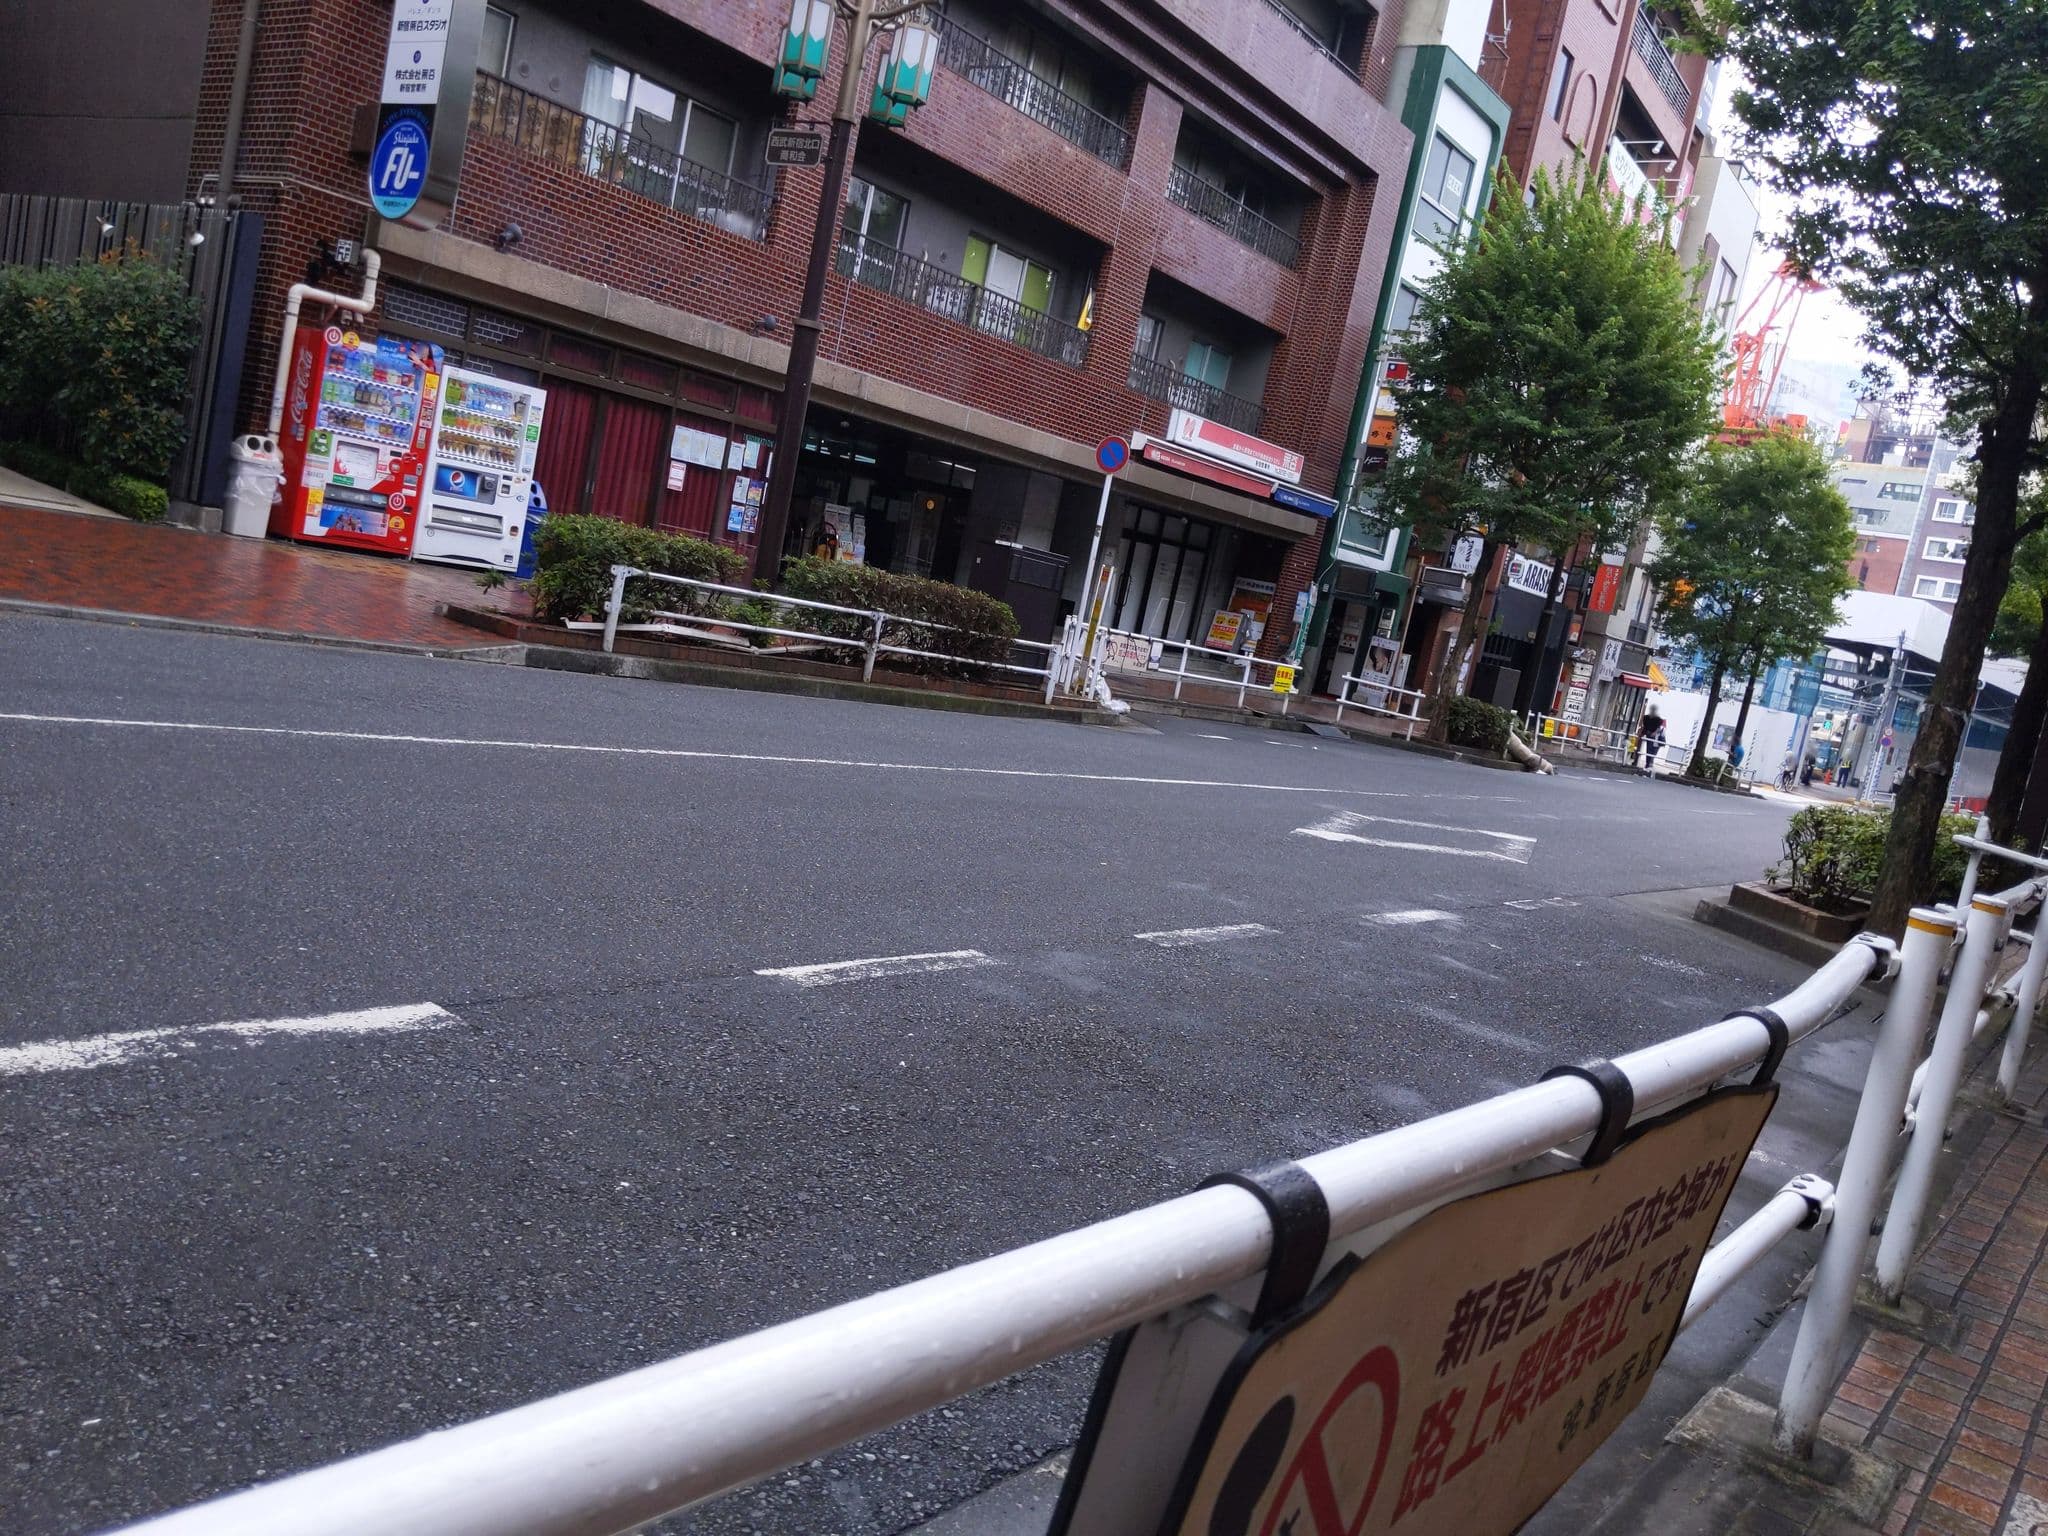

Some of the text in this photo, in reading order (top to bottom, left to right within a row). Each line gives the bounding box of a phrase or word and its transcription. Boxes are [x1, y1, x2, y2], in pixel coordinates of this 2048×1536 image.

[1434, 1153, 1736, 1378] 新宿区では区内全域が
